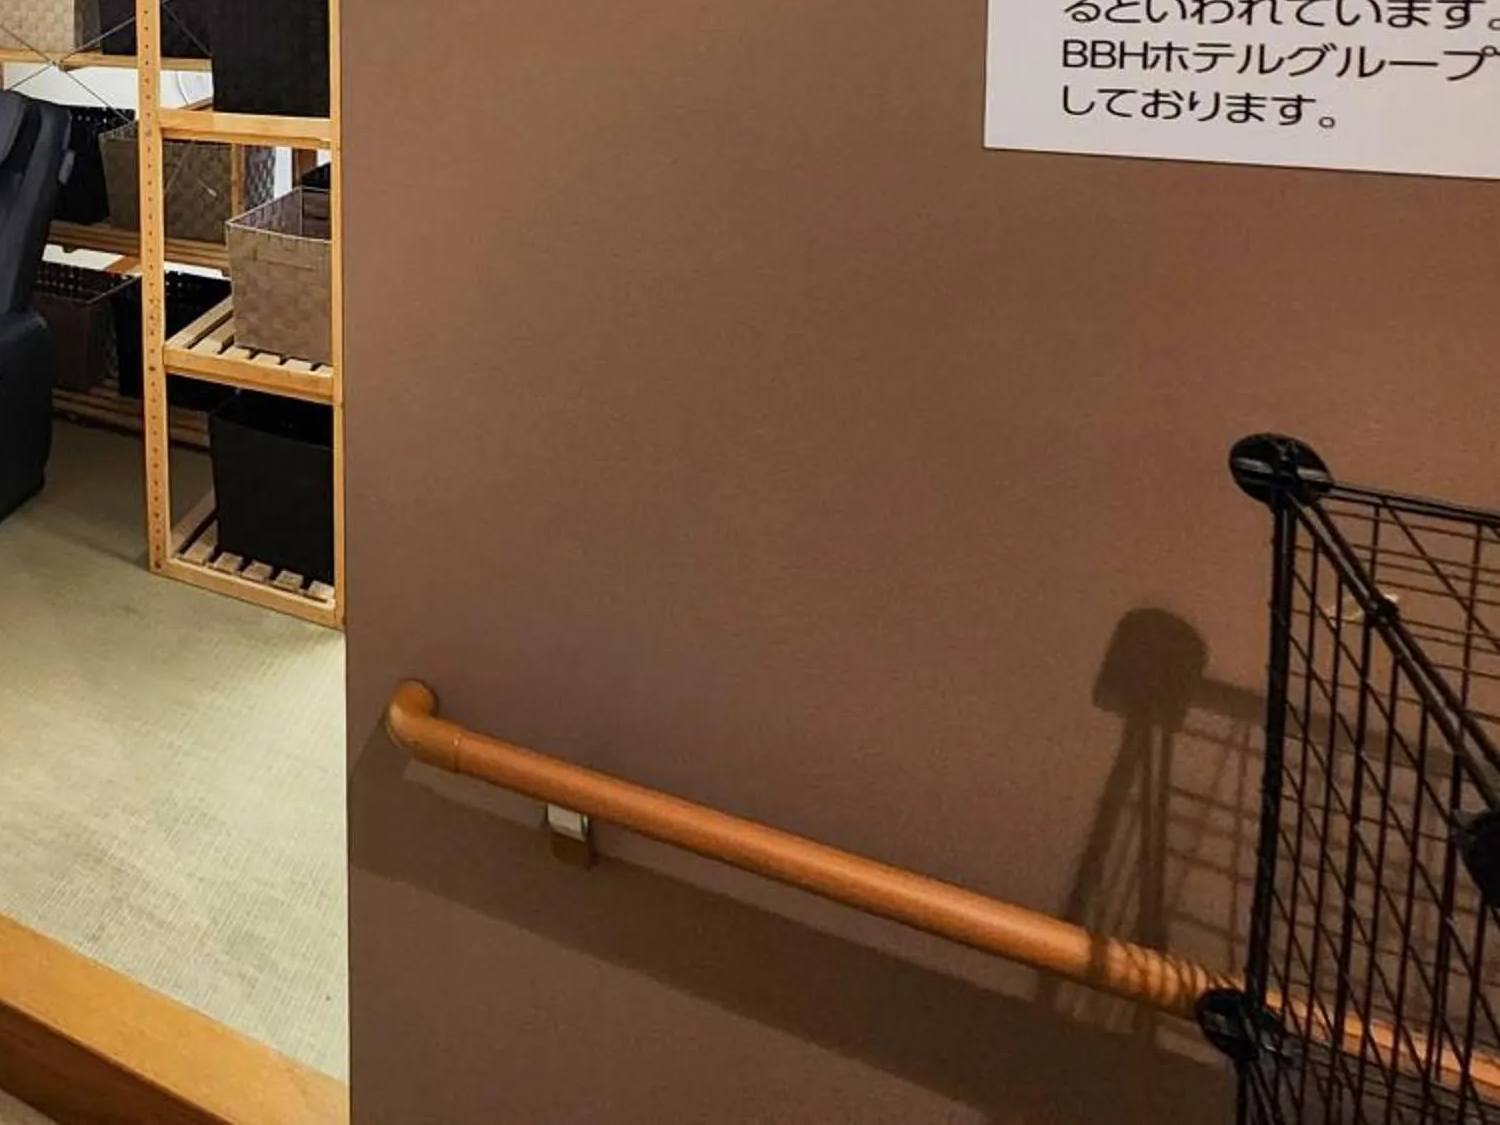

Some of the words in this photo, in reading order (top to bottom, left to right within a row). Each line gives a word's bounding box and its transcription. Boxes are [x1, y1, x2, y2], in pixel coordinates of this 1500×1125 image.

[1061, 39, 1500, 81] BBHホテルグループ
[1061, 84, 1337, 129] しております。
